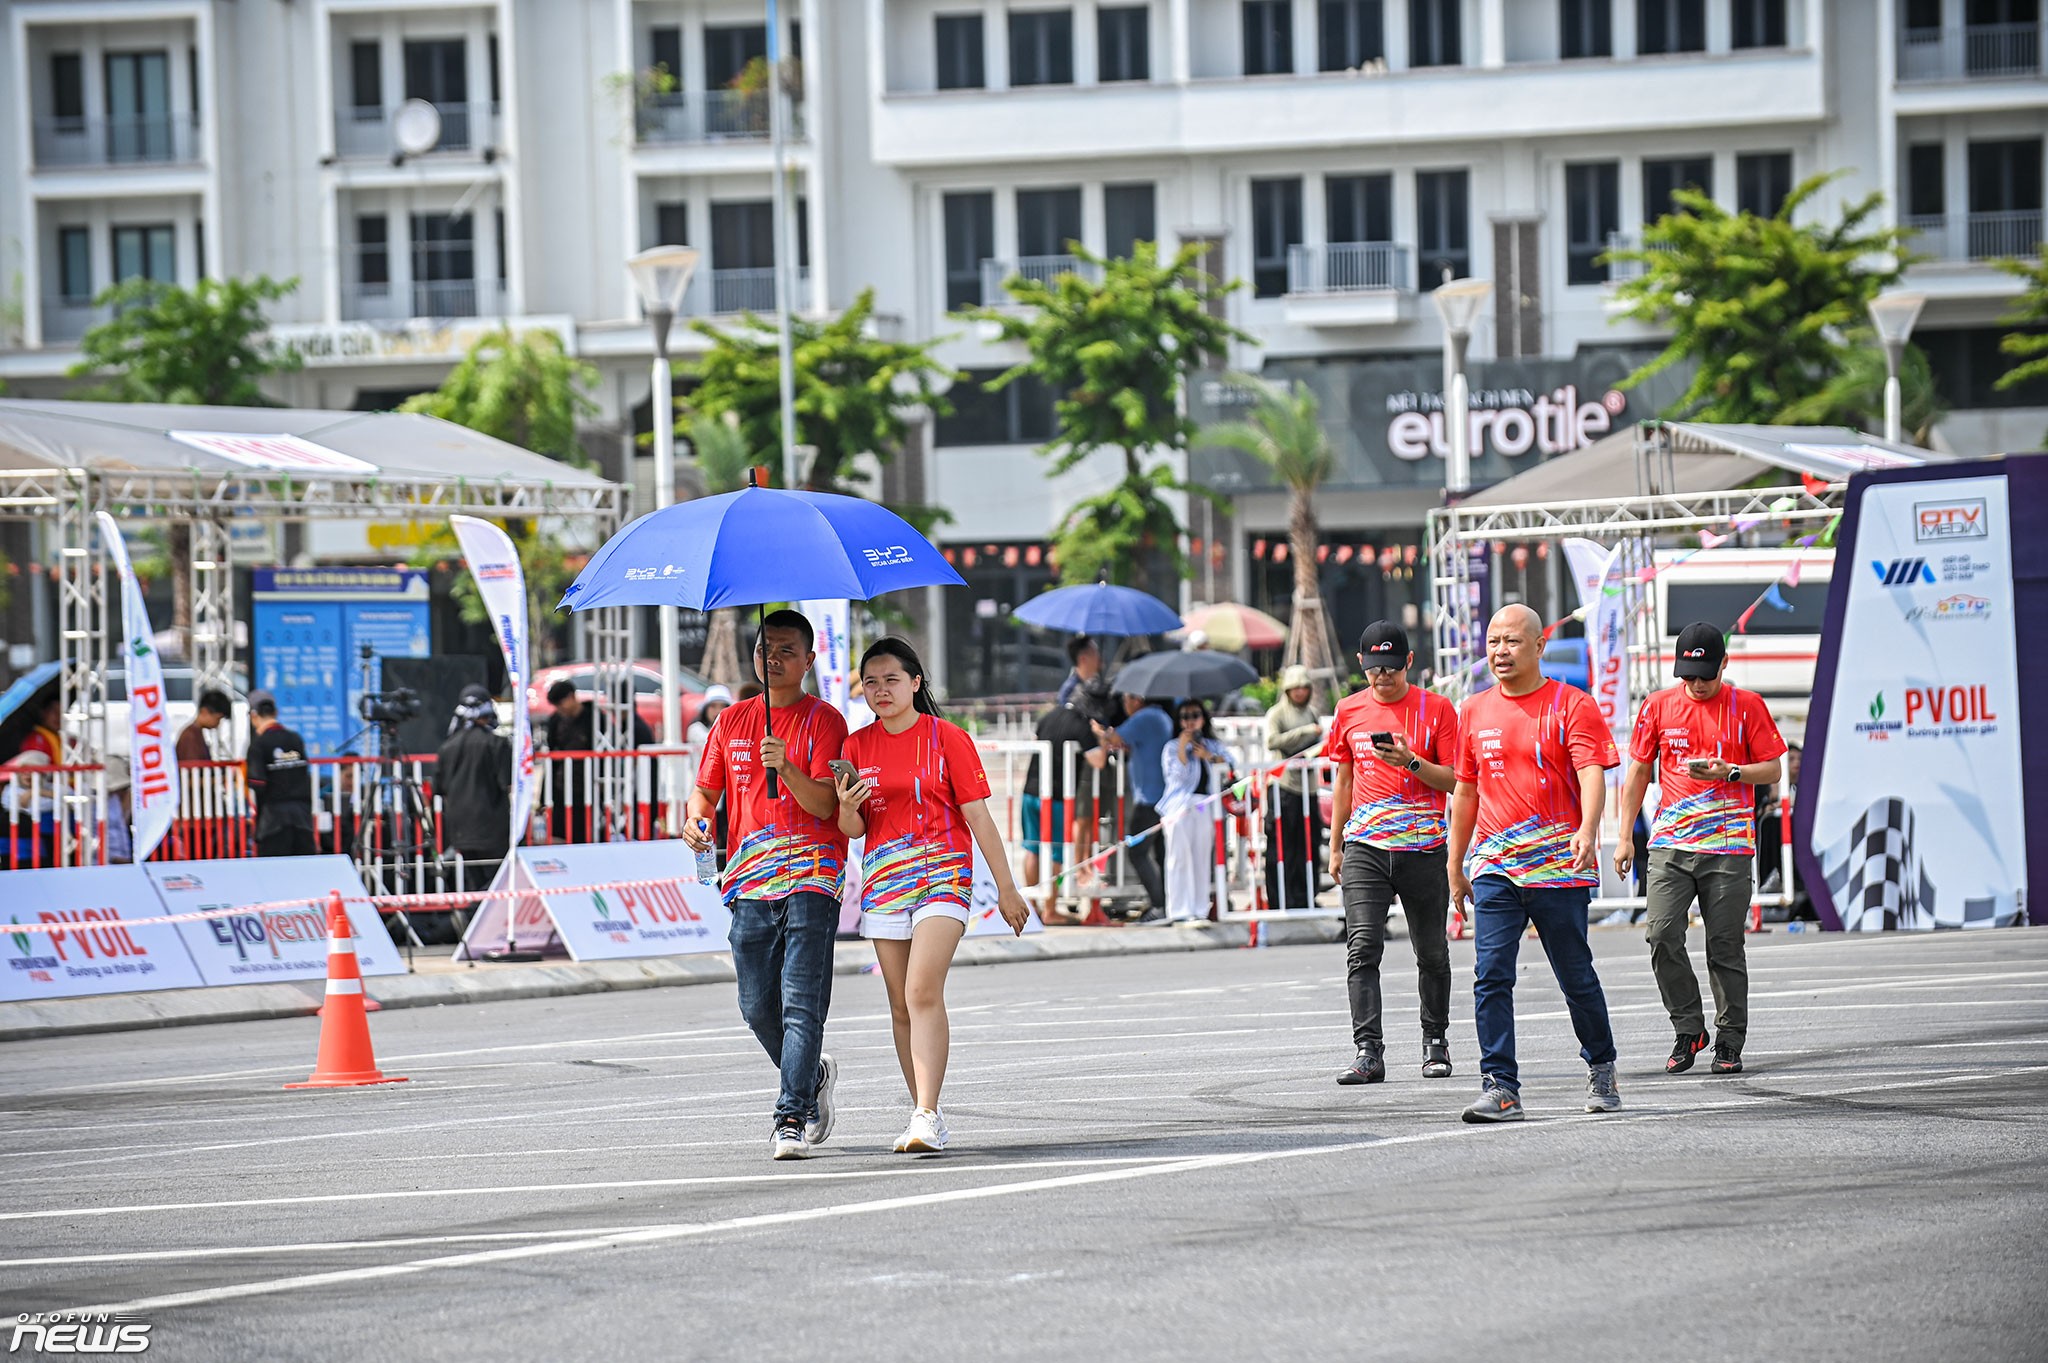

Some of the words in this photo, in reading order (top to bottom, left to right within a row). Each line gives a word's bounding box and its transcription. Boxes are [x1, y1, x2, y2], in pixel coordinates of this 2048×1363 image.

[1388, 385, 1610, 460] eurotile
[1920, 505, 1981, 525] OTV
[1921, 520, 1984, 535] MEDIA
[862, 545, 908, 561] BYD
[1905, 684, 1997, 725] PVOIL
[133, 684, 171, 809] PVOIL
[1482, 739, 1502, 750] PVOIL
[1669, 738, 1690, 748] PVOIL
[731, 751, 752, 762] PVOIL
[615, 879, 702, 925] PVOIL
[38, 907, 148, 961] PVOIL
